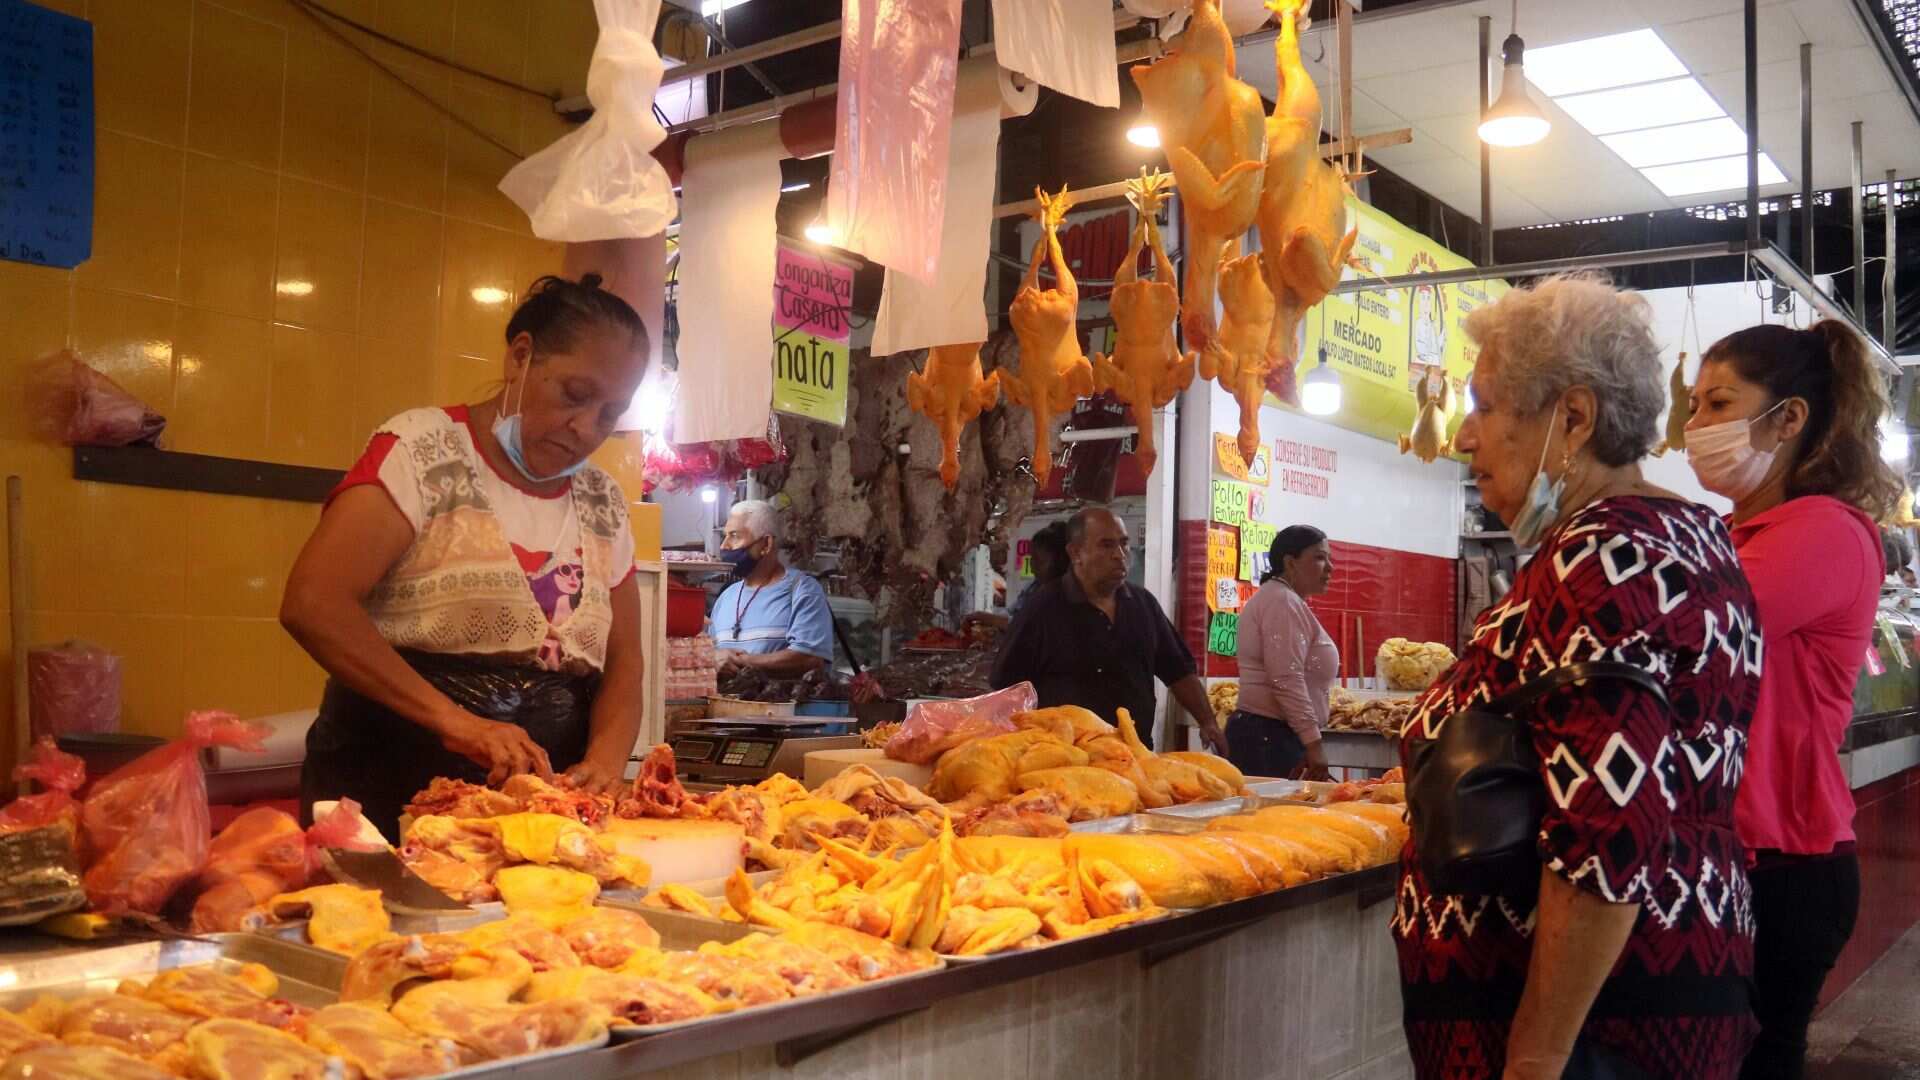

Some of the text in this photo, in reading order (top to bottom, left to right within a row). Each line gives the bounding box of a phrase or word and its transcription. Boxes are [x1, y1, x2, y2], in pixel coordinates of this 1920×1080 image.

[776, 252, 851, 299] Longaniza
[780, 286, 840, 332] Casera
[1333, 319, 1382, 354] MERCADO
[777, 336, 835, 391] nata
[1373, 359, 1387, 378] LOCAL
[1275, 438, 1302, 466] CONSERVE
[1311, 446, 1337, 472] PRODUCTO
[1212, 479, 1244, 506] Pollo
